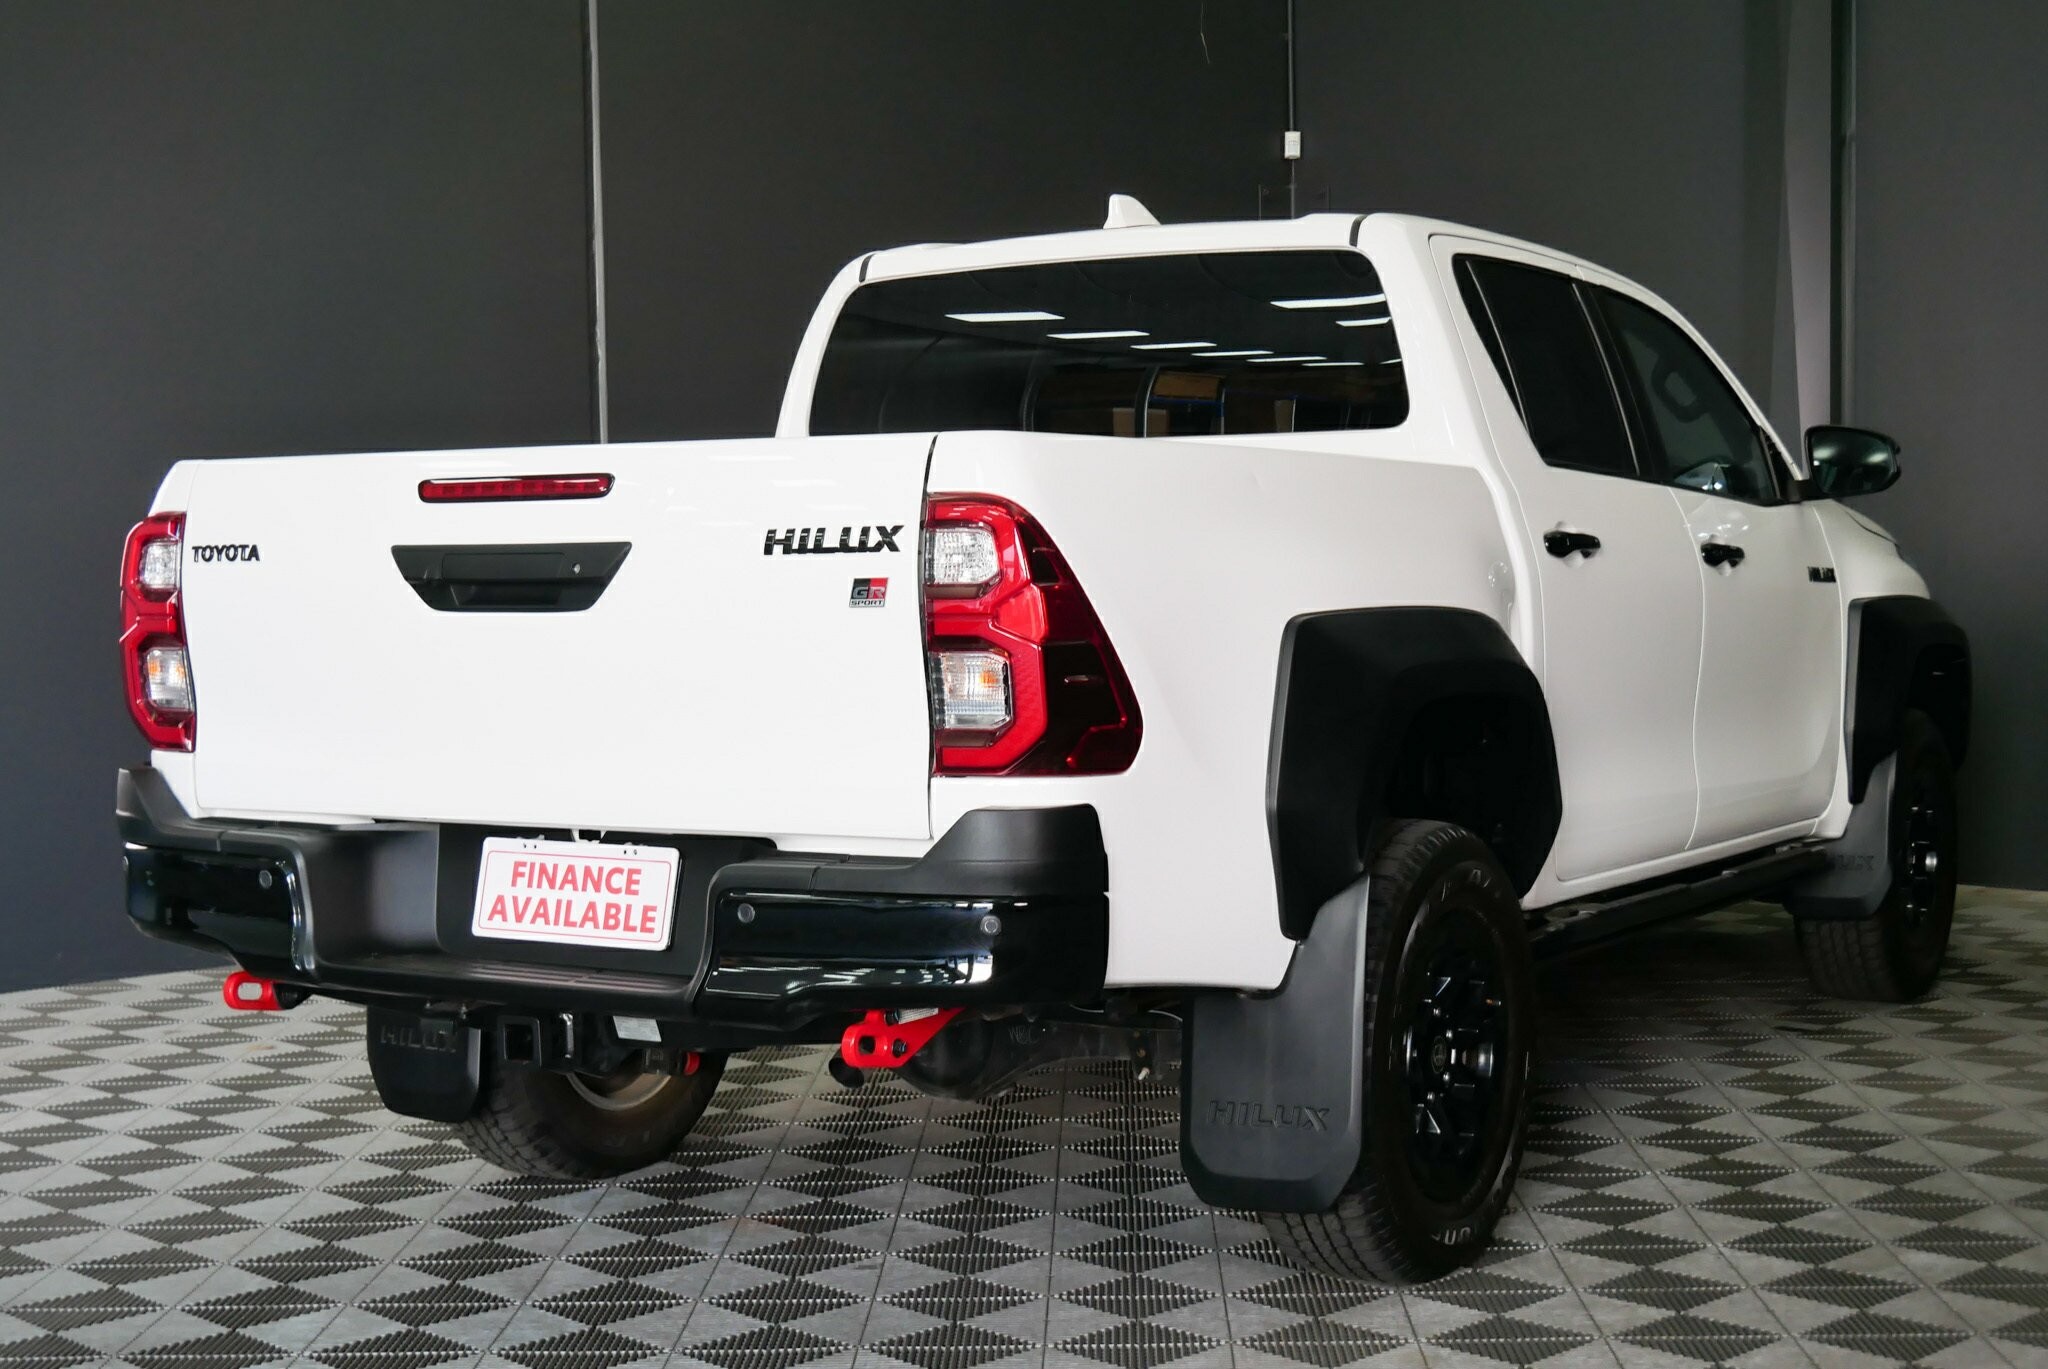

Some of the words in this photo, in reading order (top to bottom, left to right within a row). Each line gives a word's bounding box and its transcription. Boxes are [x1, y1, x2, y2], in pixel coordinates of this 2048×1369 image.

[192, 544, 260, 562] TOYOTA
[764, 525, 904, 555] HILUX
[853, 586, 886, 599] GR
[511, 861, 642, 895] FINANCE
[487, 894, 658, 934] AVAILABLE
[1207, 1100, 1330, 1132] HILUX
